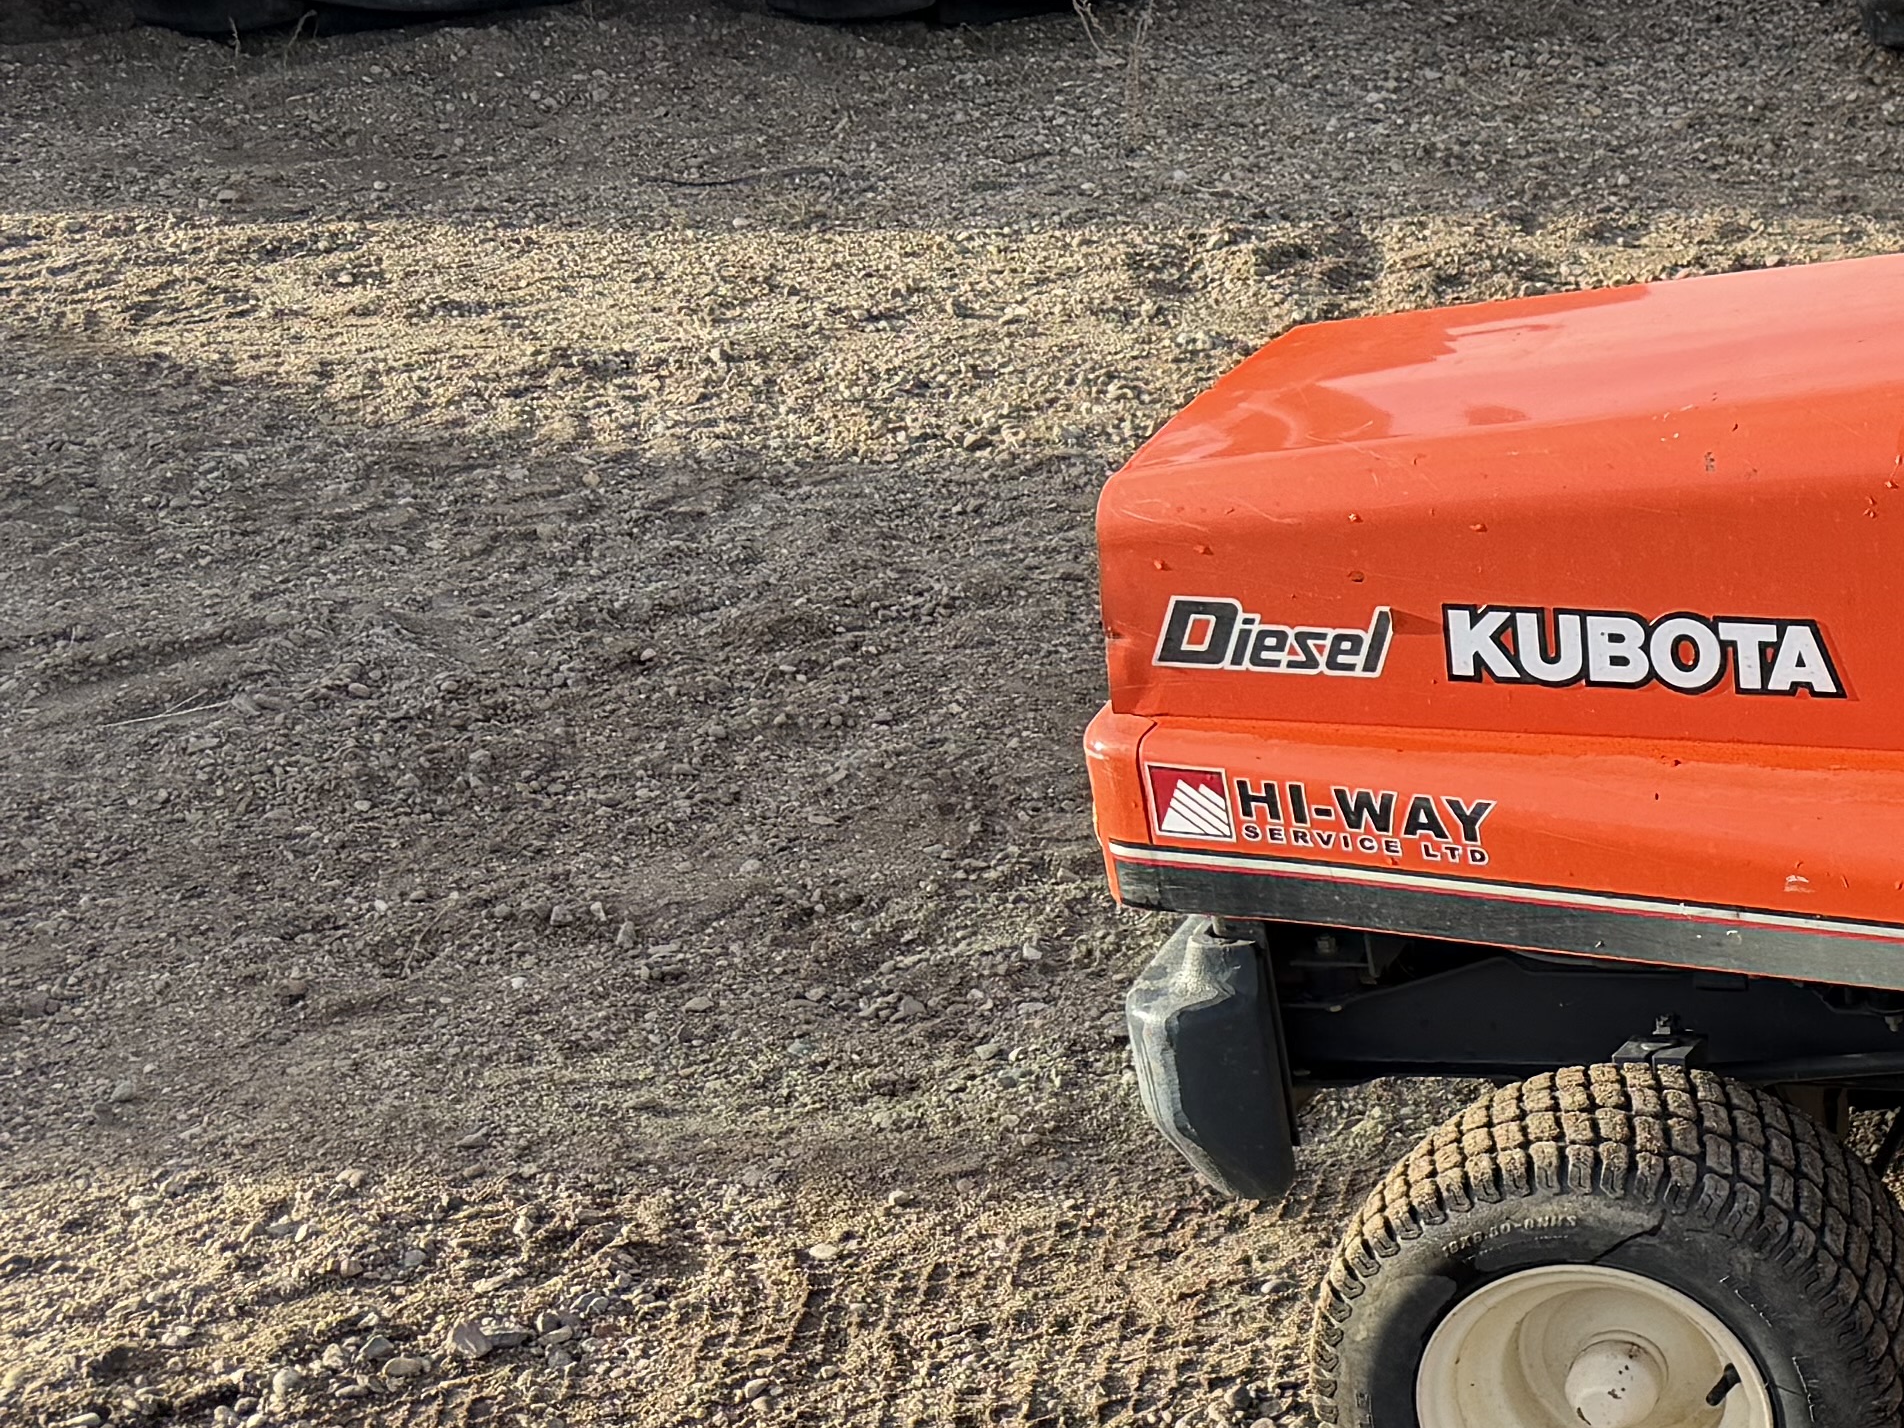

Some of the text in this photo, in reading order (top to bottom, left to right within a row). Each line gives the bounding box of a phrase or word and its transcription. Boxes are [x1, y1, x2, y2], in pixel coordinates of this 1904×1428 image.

[1154, 598, 1391, 677] Diesel
[1444, 604, 1844, 696] KUBOTA
[1235, 779, 1496, 843] HI-WAY
[1243, 824, 1490, 865] SERVICE LTD
